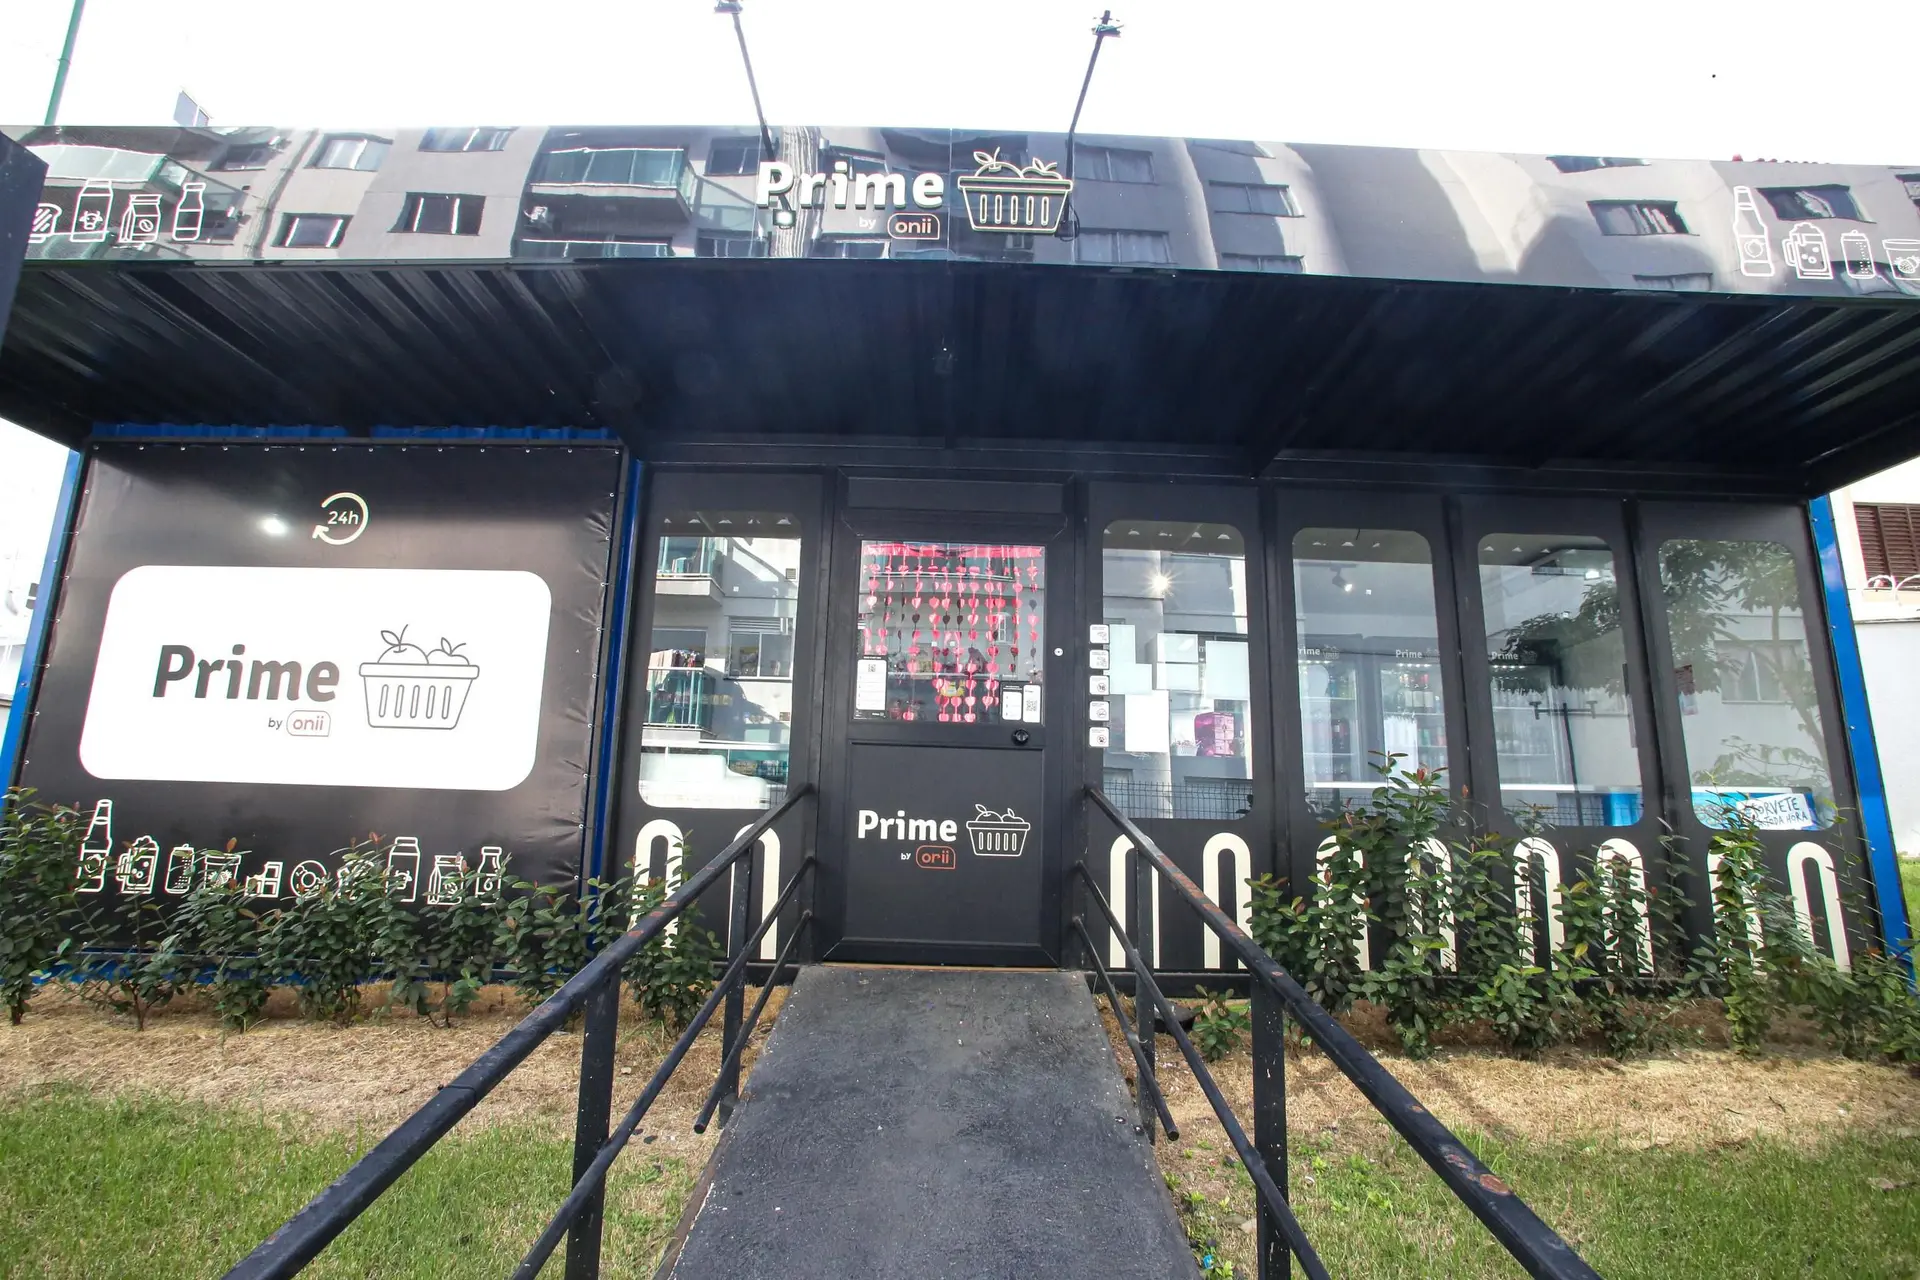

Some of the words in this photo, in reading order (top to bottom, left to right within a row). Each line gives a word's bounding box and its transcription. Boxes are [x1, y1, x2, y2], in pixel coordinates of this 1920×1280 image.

[756, 161, 944, 210] Prime
[859, 217, 877, 230] by
[895, 218, 932, 234] onii
[327, 510, 359, 525] 24h
[1298, 646, 1321, 656] rime
[1395, 649, 1423, 659] Prime
[153, 644, 340, 702] Prime
[268, 717, 283, 730] by
[292, 715, 324, 731] onii
[1786, 811, 1808, 824] HORA
[857, 809, 958, 842] Prime
[900, 852, 912, 861] by
